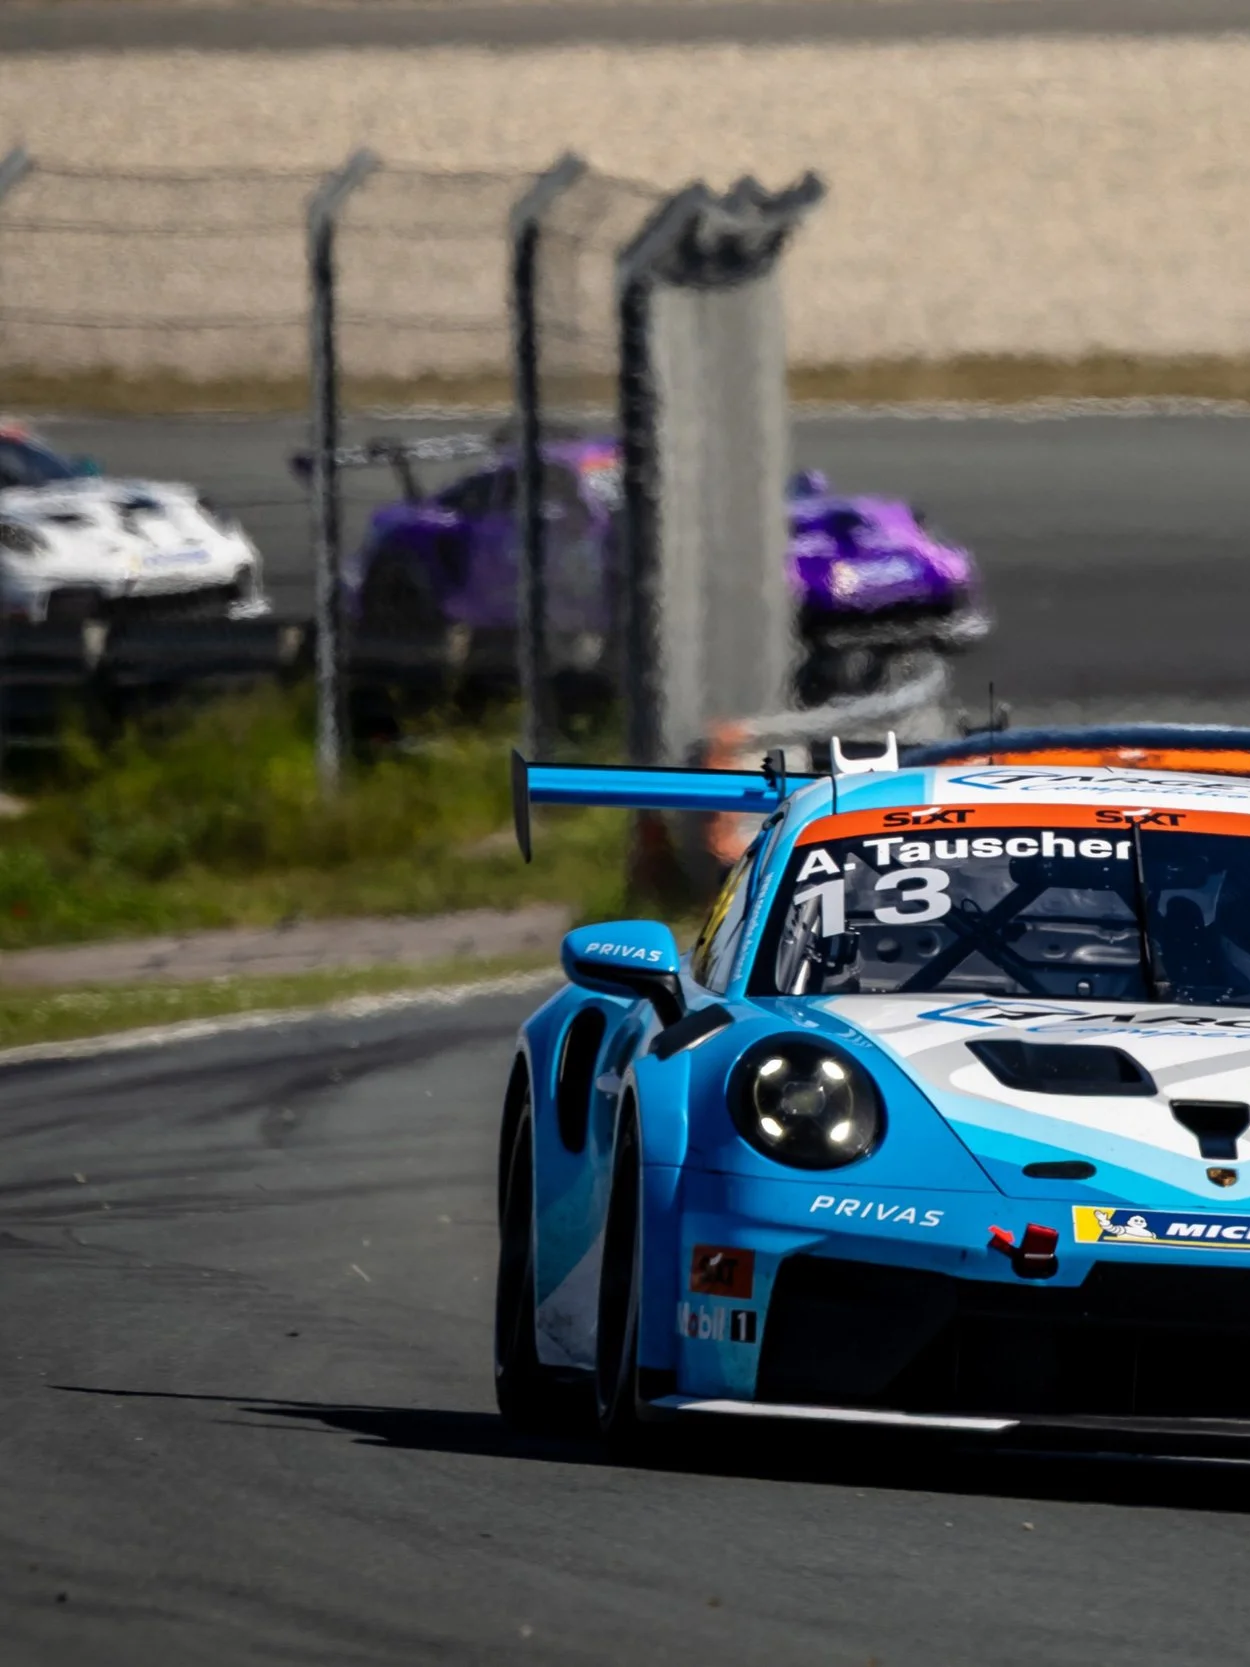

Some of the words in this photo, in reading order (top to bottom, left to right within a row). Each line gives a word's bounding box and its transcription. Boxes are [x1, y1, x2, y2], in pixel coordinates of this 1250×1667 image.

[796, 848, 856, 882] A.
[863, 831, 1133, 866] Tauscher
[794, 867, 951, 938] 13
[584, 942, 663, 962] PRIVAS
[809, 1195, 945, 1227] PRIVAS
